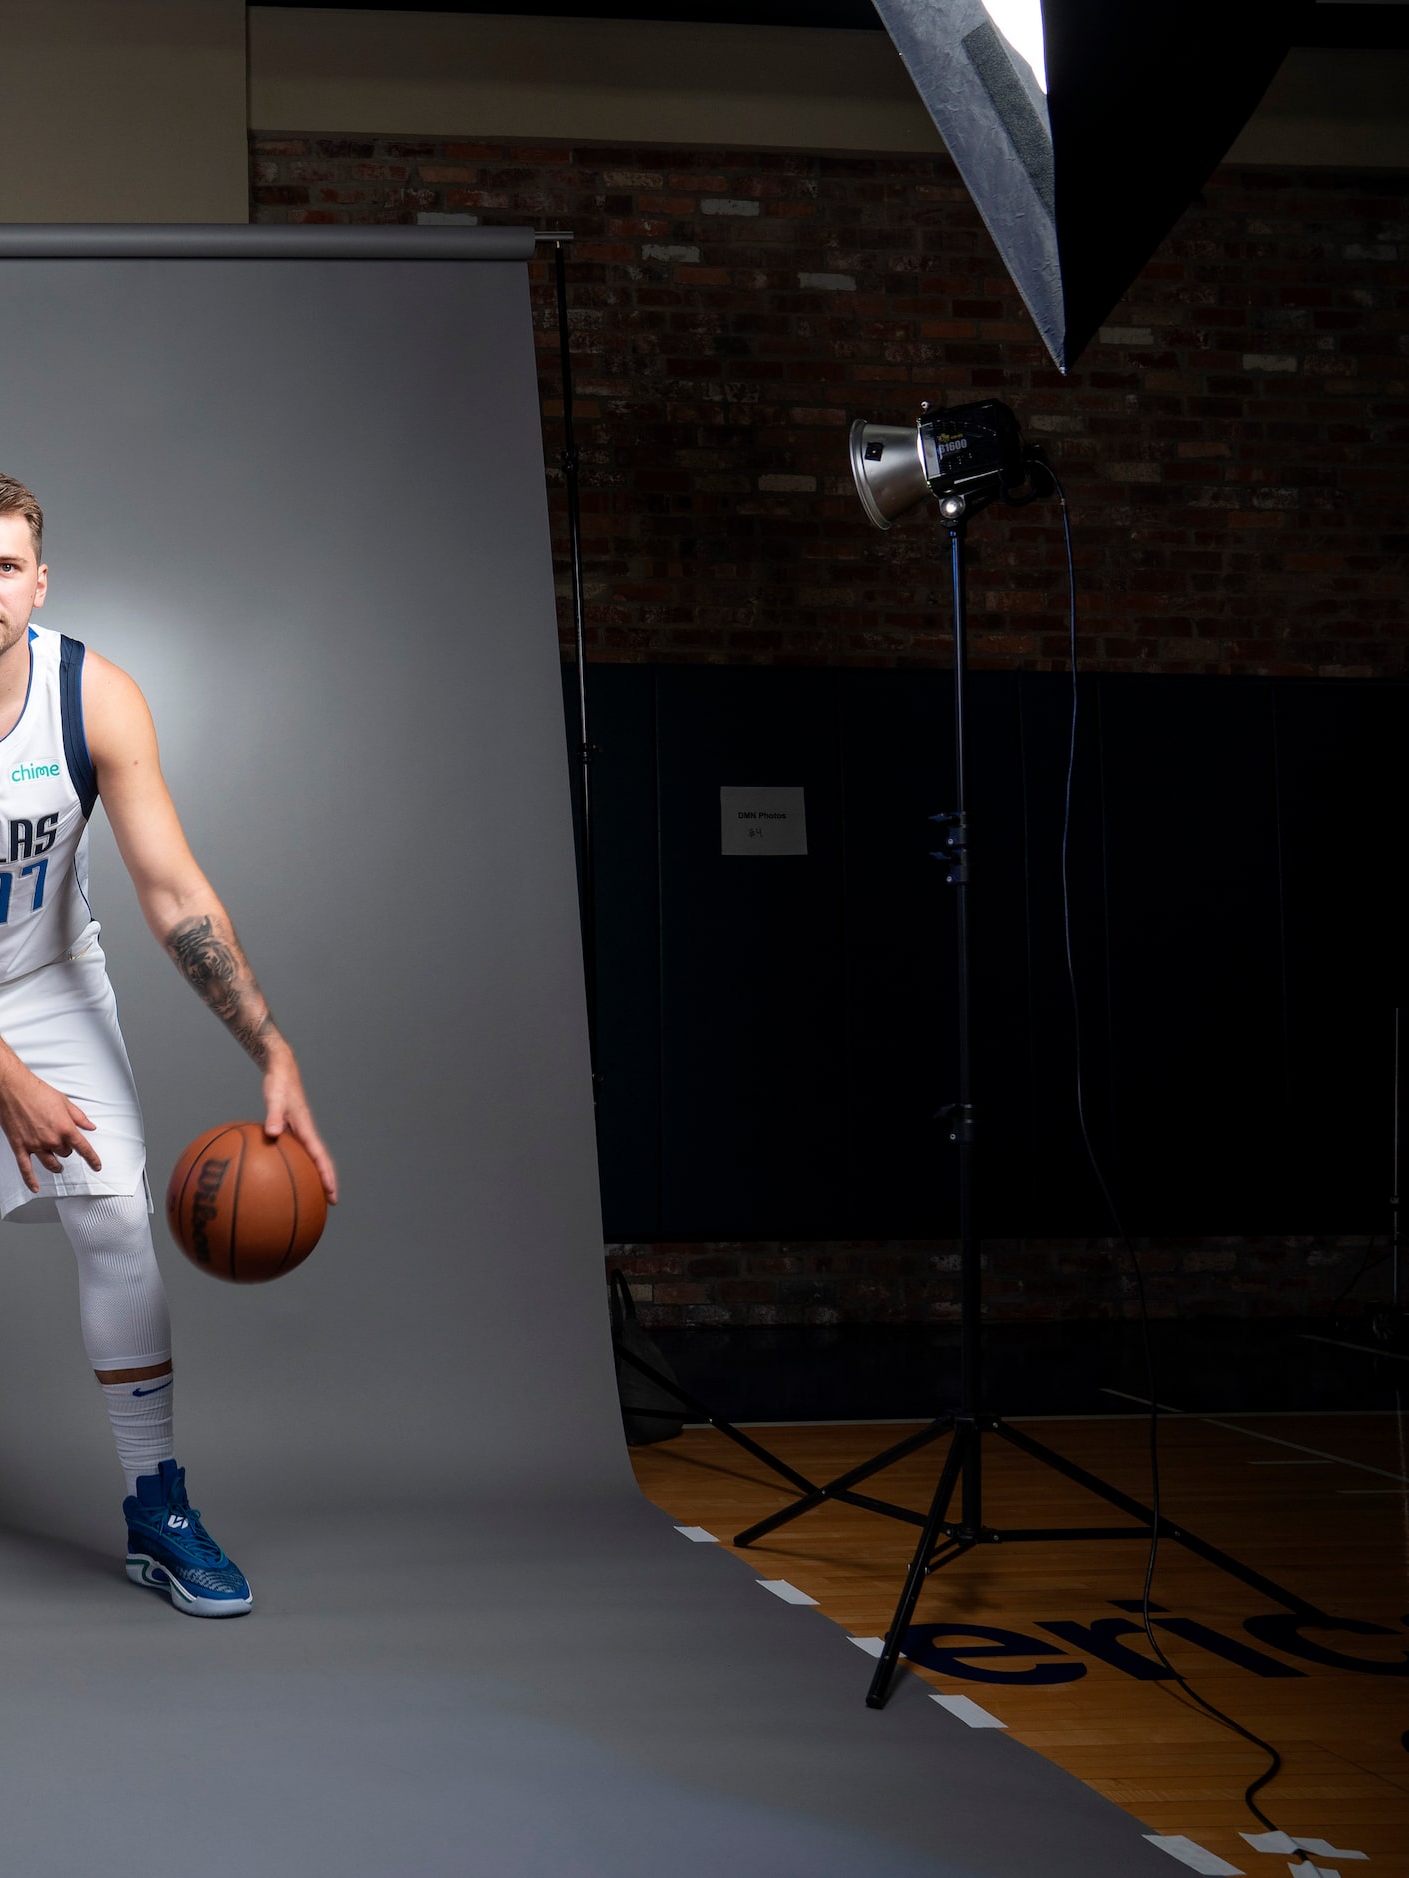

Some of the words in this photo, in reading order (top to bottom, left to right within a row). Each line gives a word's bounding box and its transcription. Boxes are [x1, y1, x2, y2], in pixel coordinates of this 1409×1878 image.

[11, 761, 61, 783] chime
[759, 811, 787, 820] Photos
[885, 1600, 1409, 1684] eric
